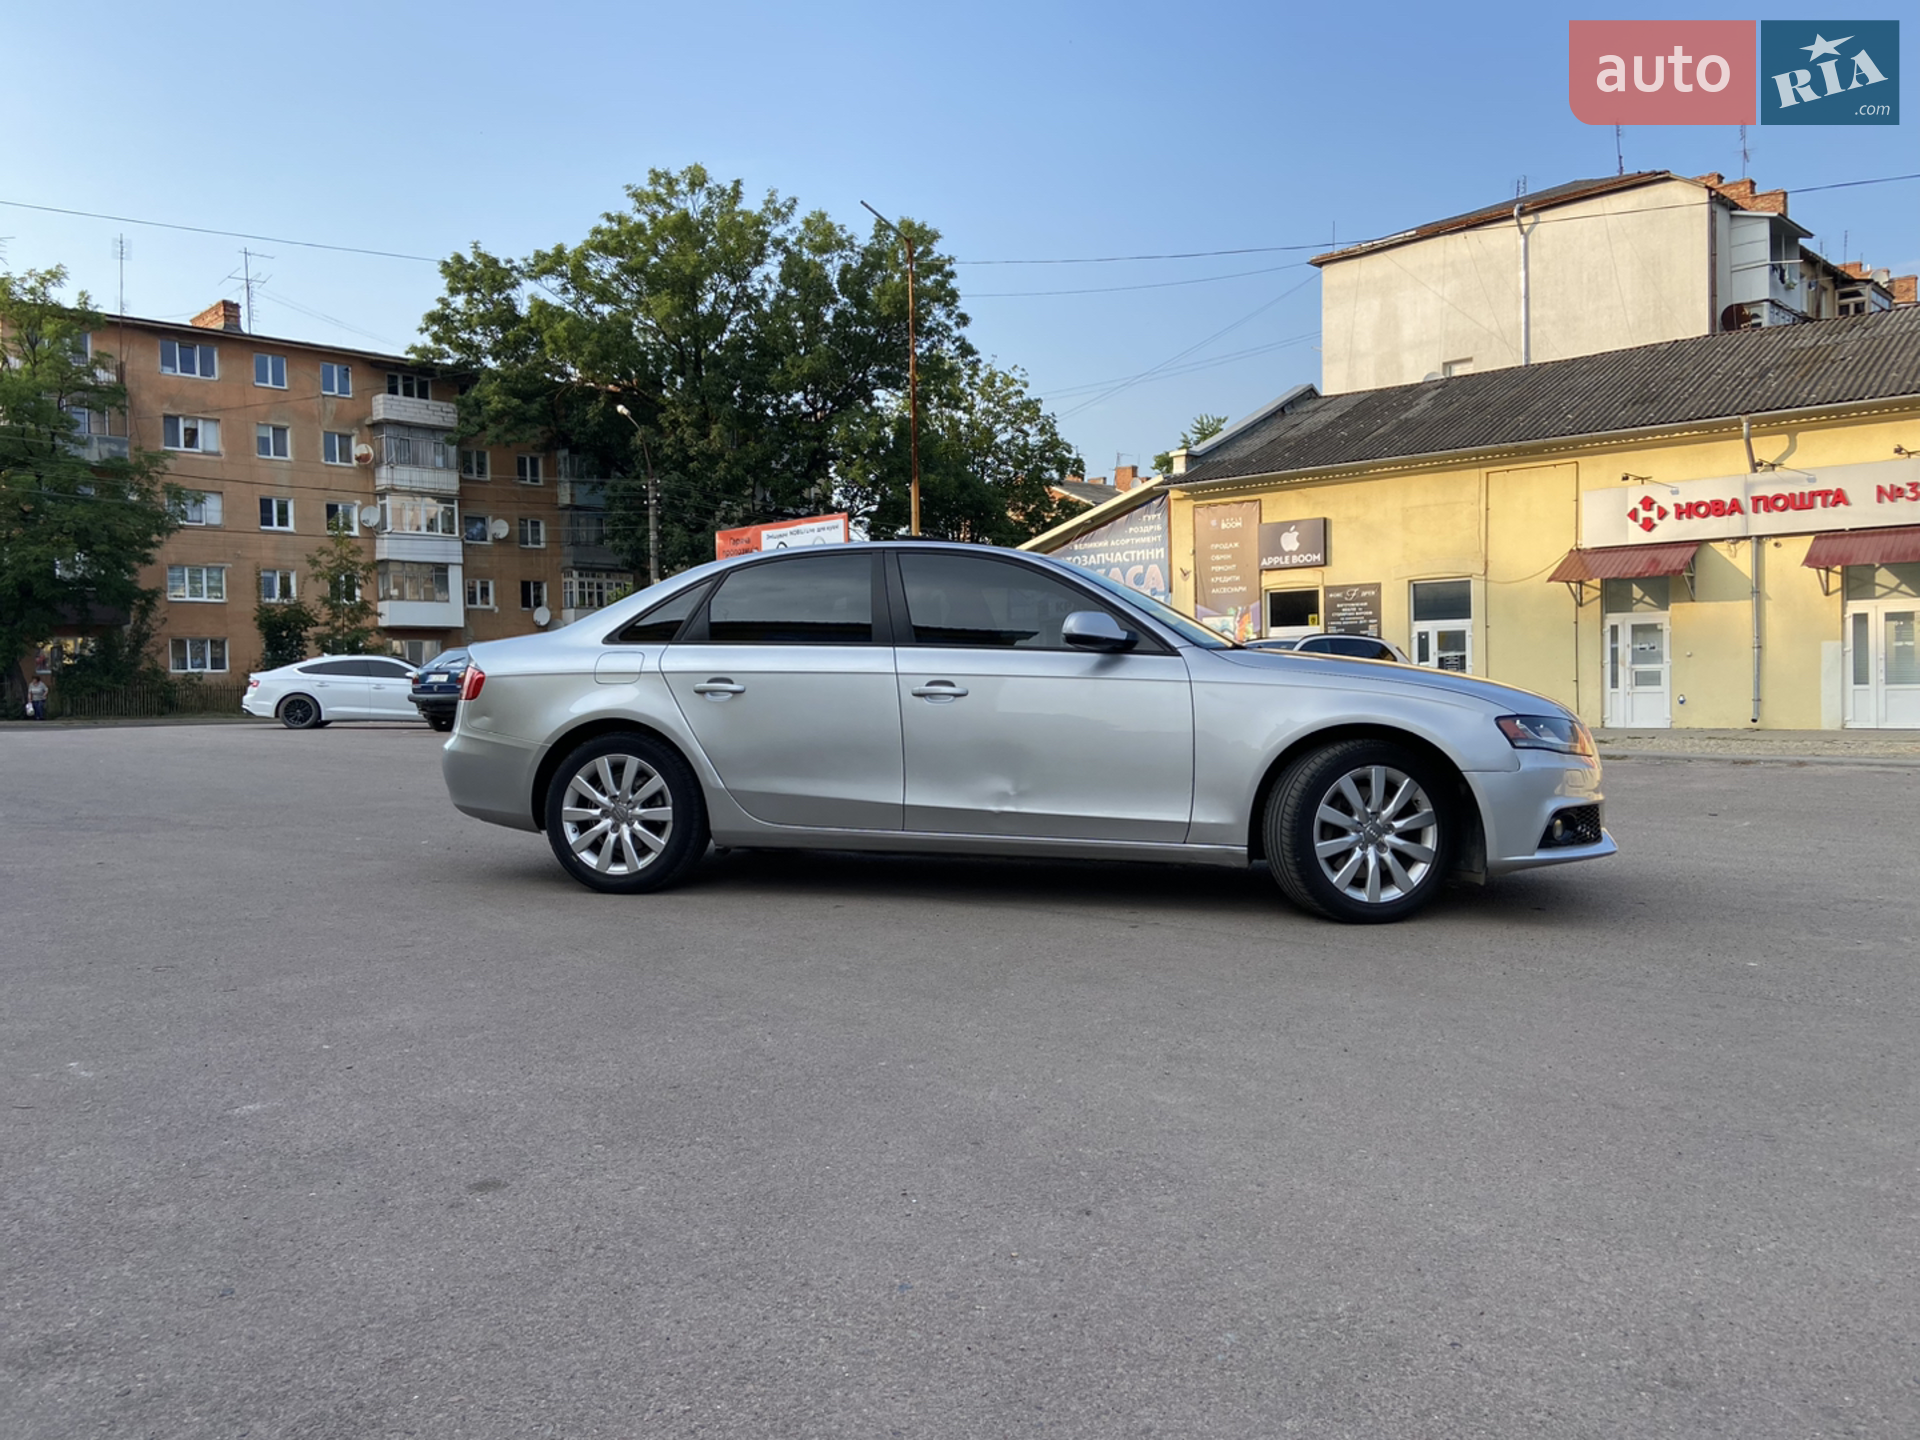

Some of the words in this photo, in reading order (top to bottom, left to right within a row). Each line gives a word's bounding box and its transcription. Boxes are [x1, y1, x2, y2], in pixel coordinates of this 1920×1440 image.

[1674, 497, 1744, 520] НОВА
[1751, 487, 1849, 514] ПОШТА
[1110, 535, 1162, 547] АСОРТИМЕНТ
[1062, 547, 1165, 567] ТОЗАПЧАСТИНИ
[1260, 555, 1290, 566] APPLE
[1291, 553, 1321, 564] BOOM
